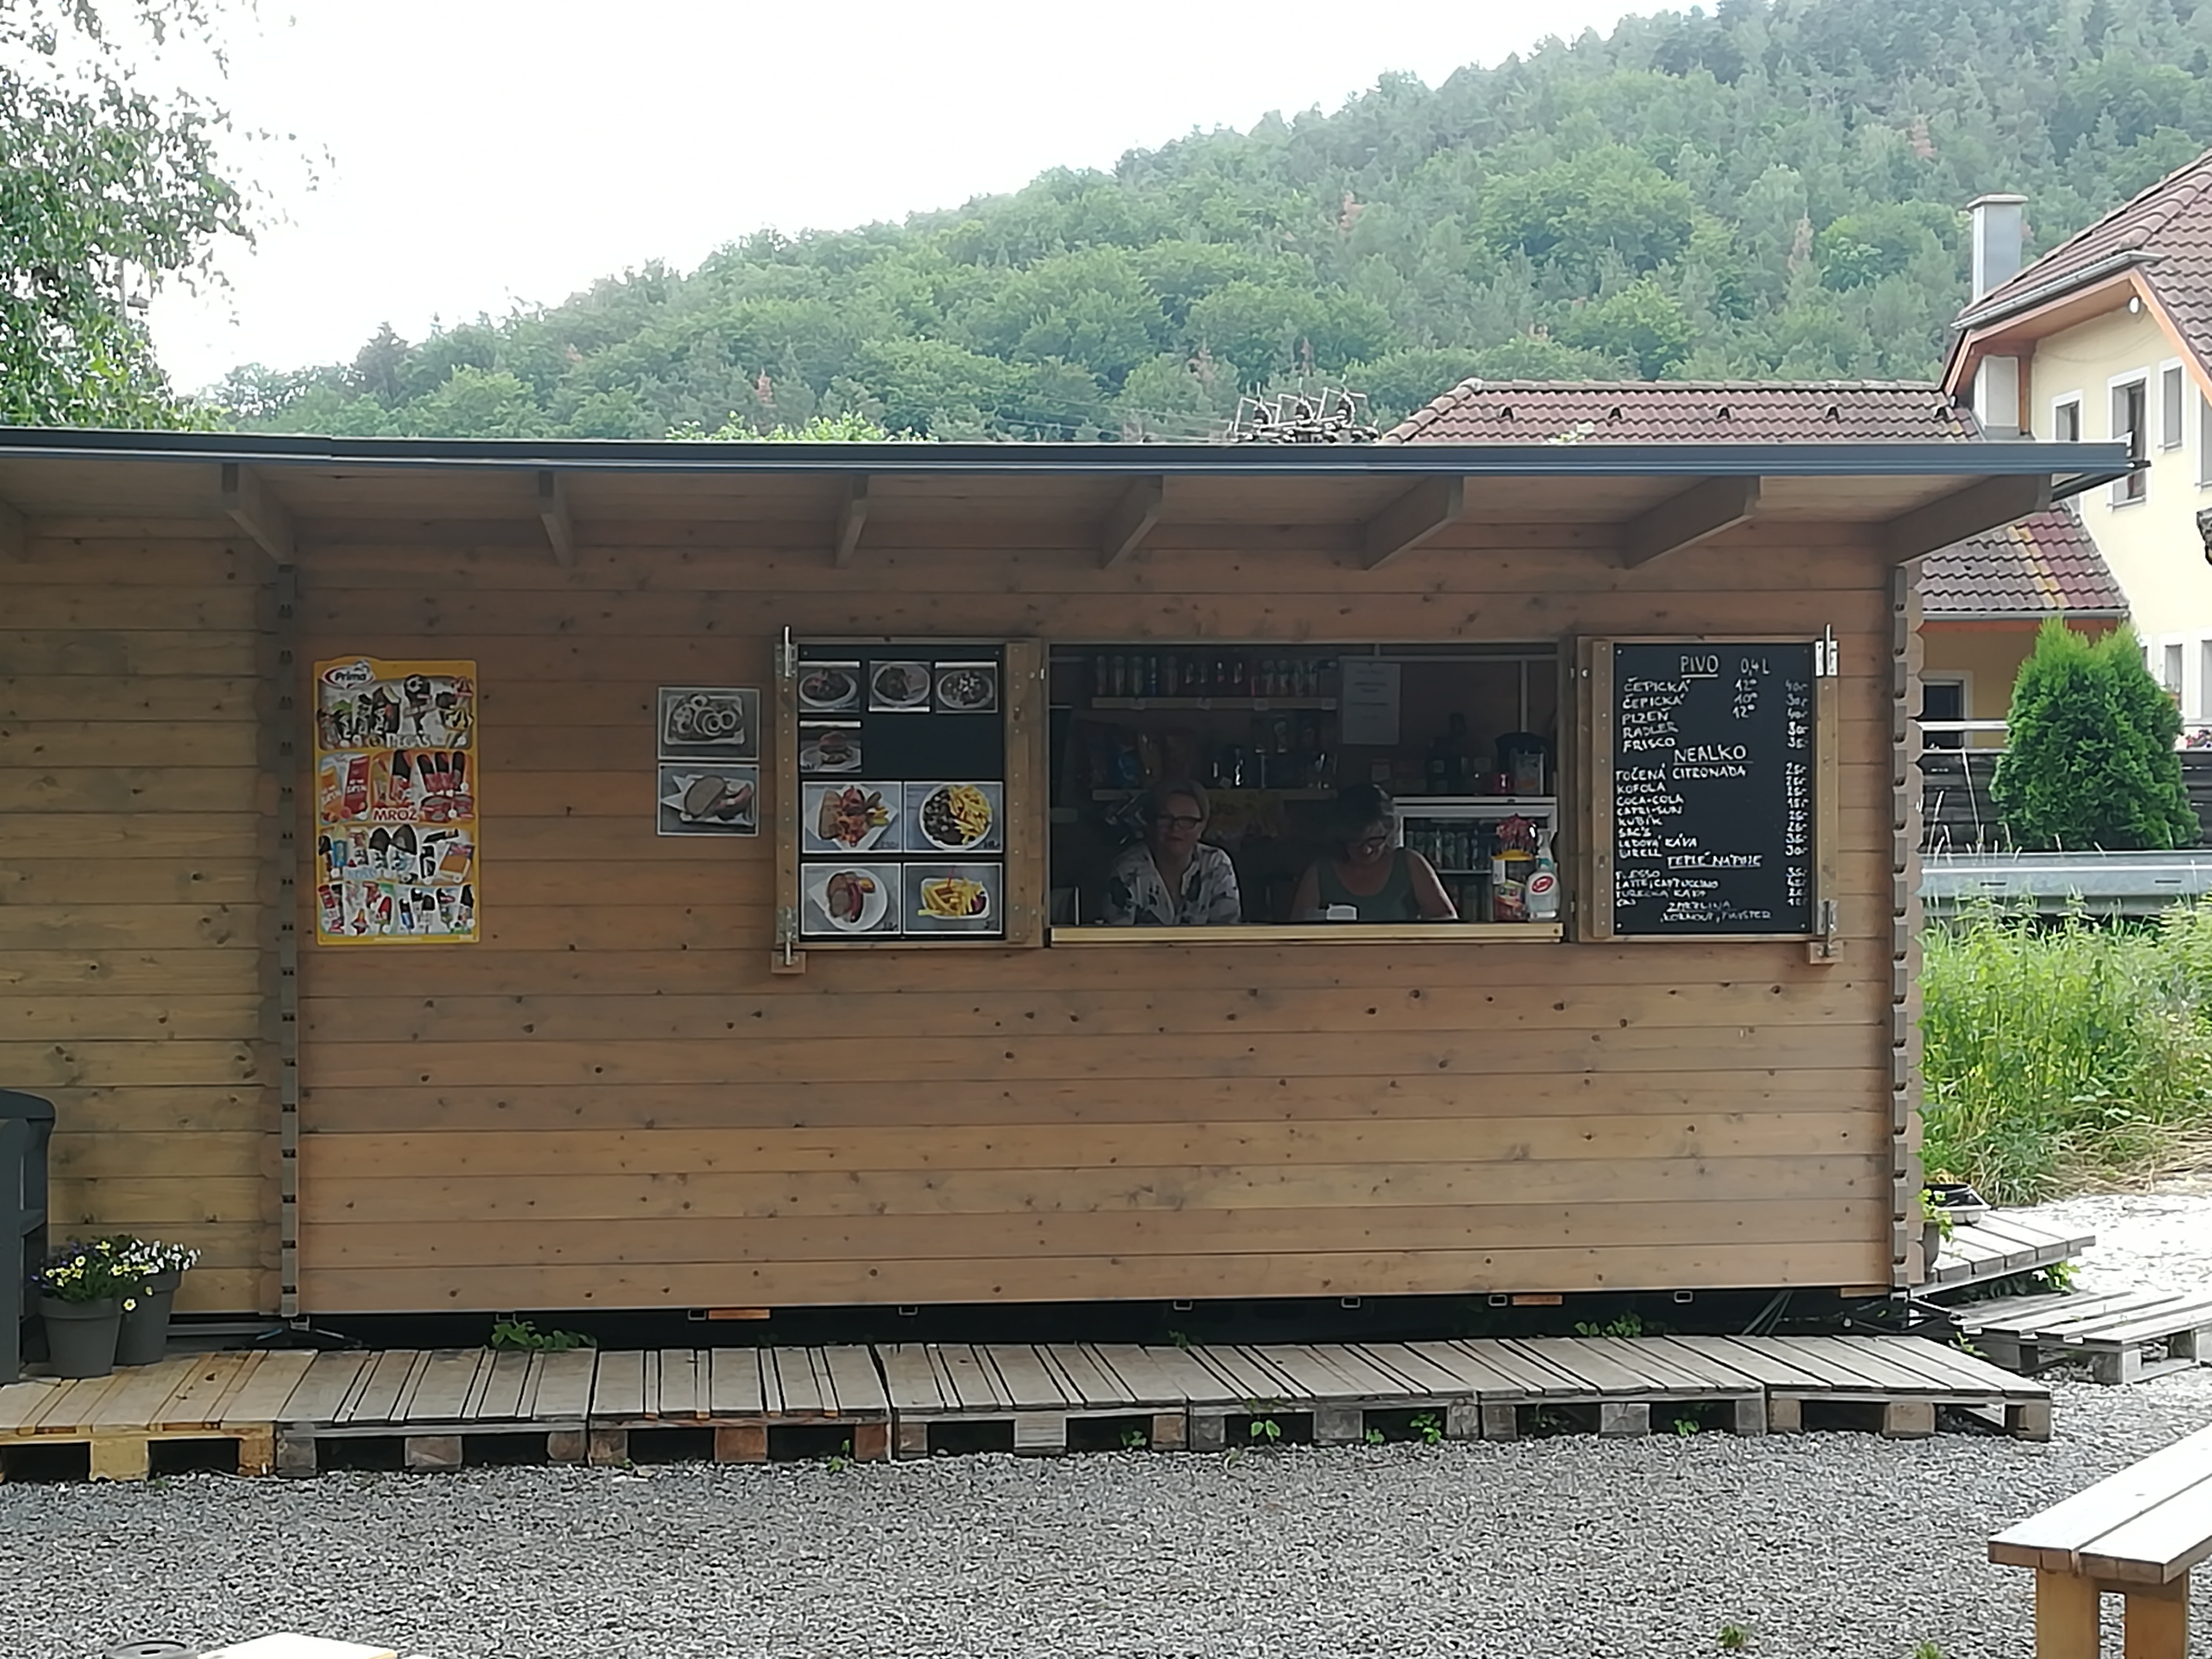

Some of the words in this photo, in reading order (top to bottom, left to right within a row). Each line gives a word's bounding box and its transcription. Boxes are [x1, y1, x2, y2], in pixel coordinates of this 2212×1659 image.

[1680, 654, 1719, 673] PIVO
[334, 671, 367, 682] Prima
[1622, 707, 1672, 725] PLZEŇ
[1623, 721, 1679, 739] RADLER
[1623, 738, 1676, 753] FRISCO
[1674, 744, 1747, 763] NEALKO
[1616, 763, 1667, 781] TOČENÁ
[1672, 764, 1746, 780] CITRONADA
[1617, 782, 1666, 794] KOFOLA
[1616, 793, 1684, 806] COCA-COLA
[1665, 833, 1697, 847] KÁVA
